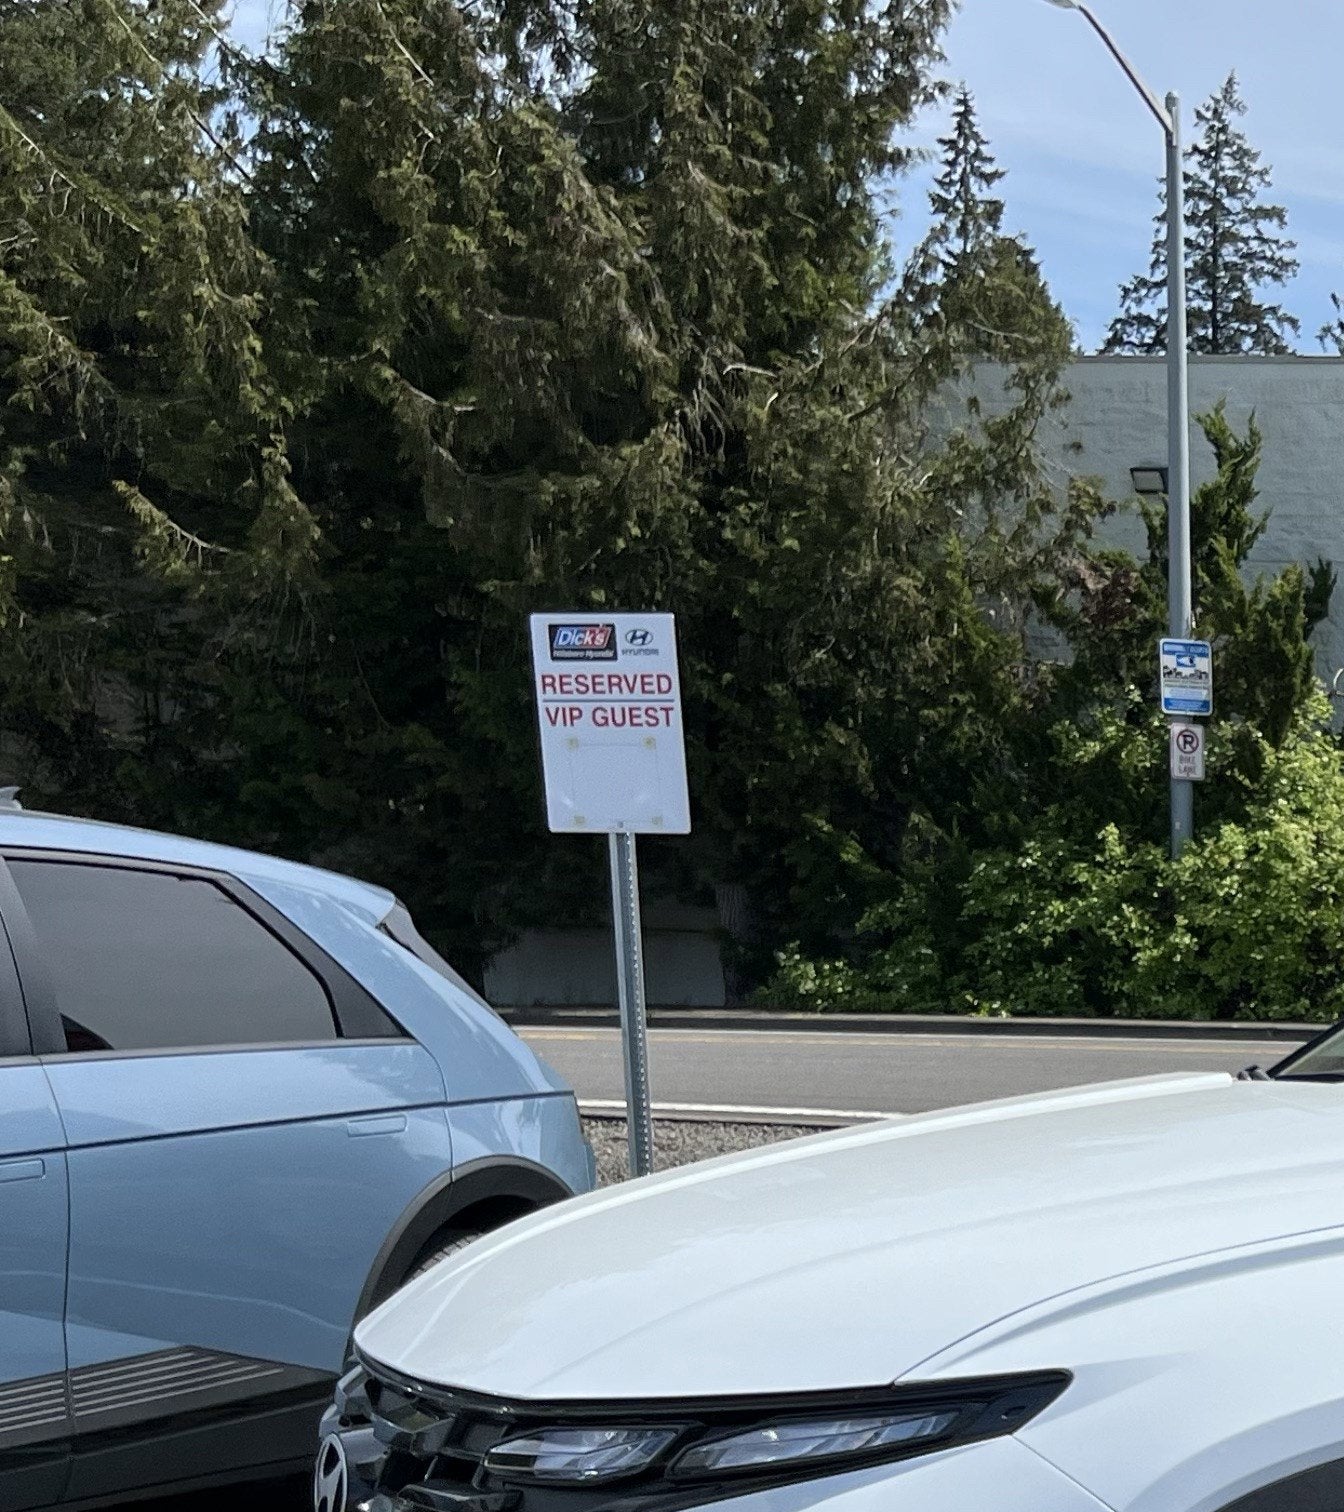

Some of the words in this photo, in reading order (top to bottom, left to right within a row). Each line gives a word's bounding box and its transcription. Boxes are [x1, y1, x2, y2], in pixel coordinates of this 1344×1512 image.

[541, 673, 673, 695] RESERVED
[545, 706, 583, 727] VIP
[592, 706, 675, 728] GUEST
